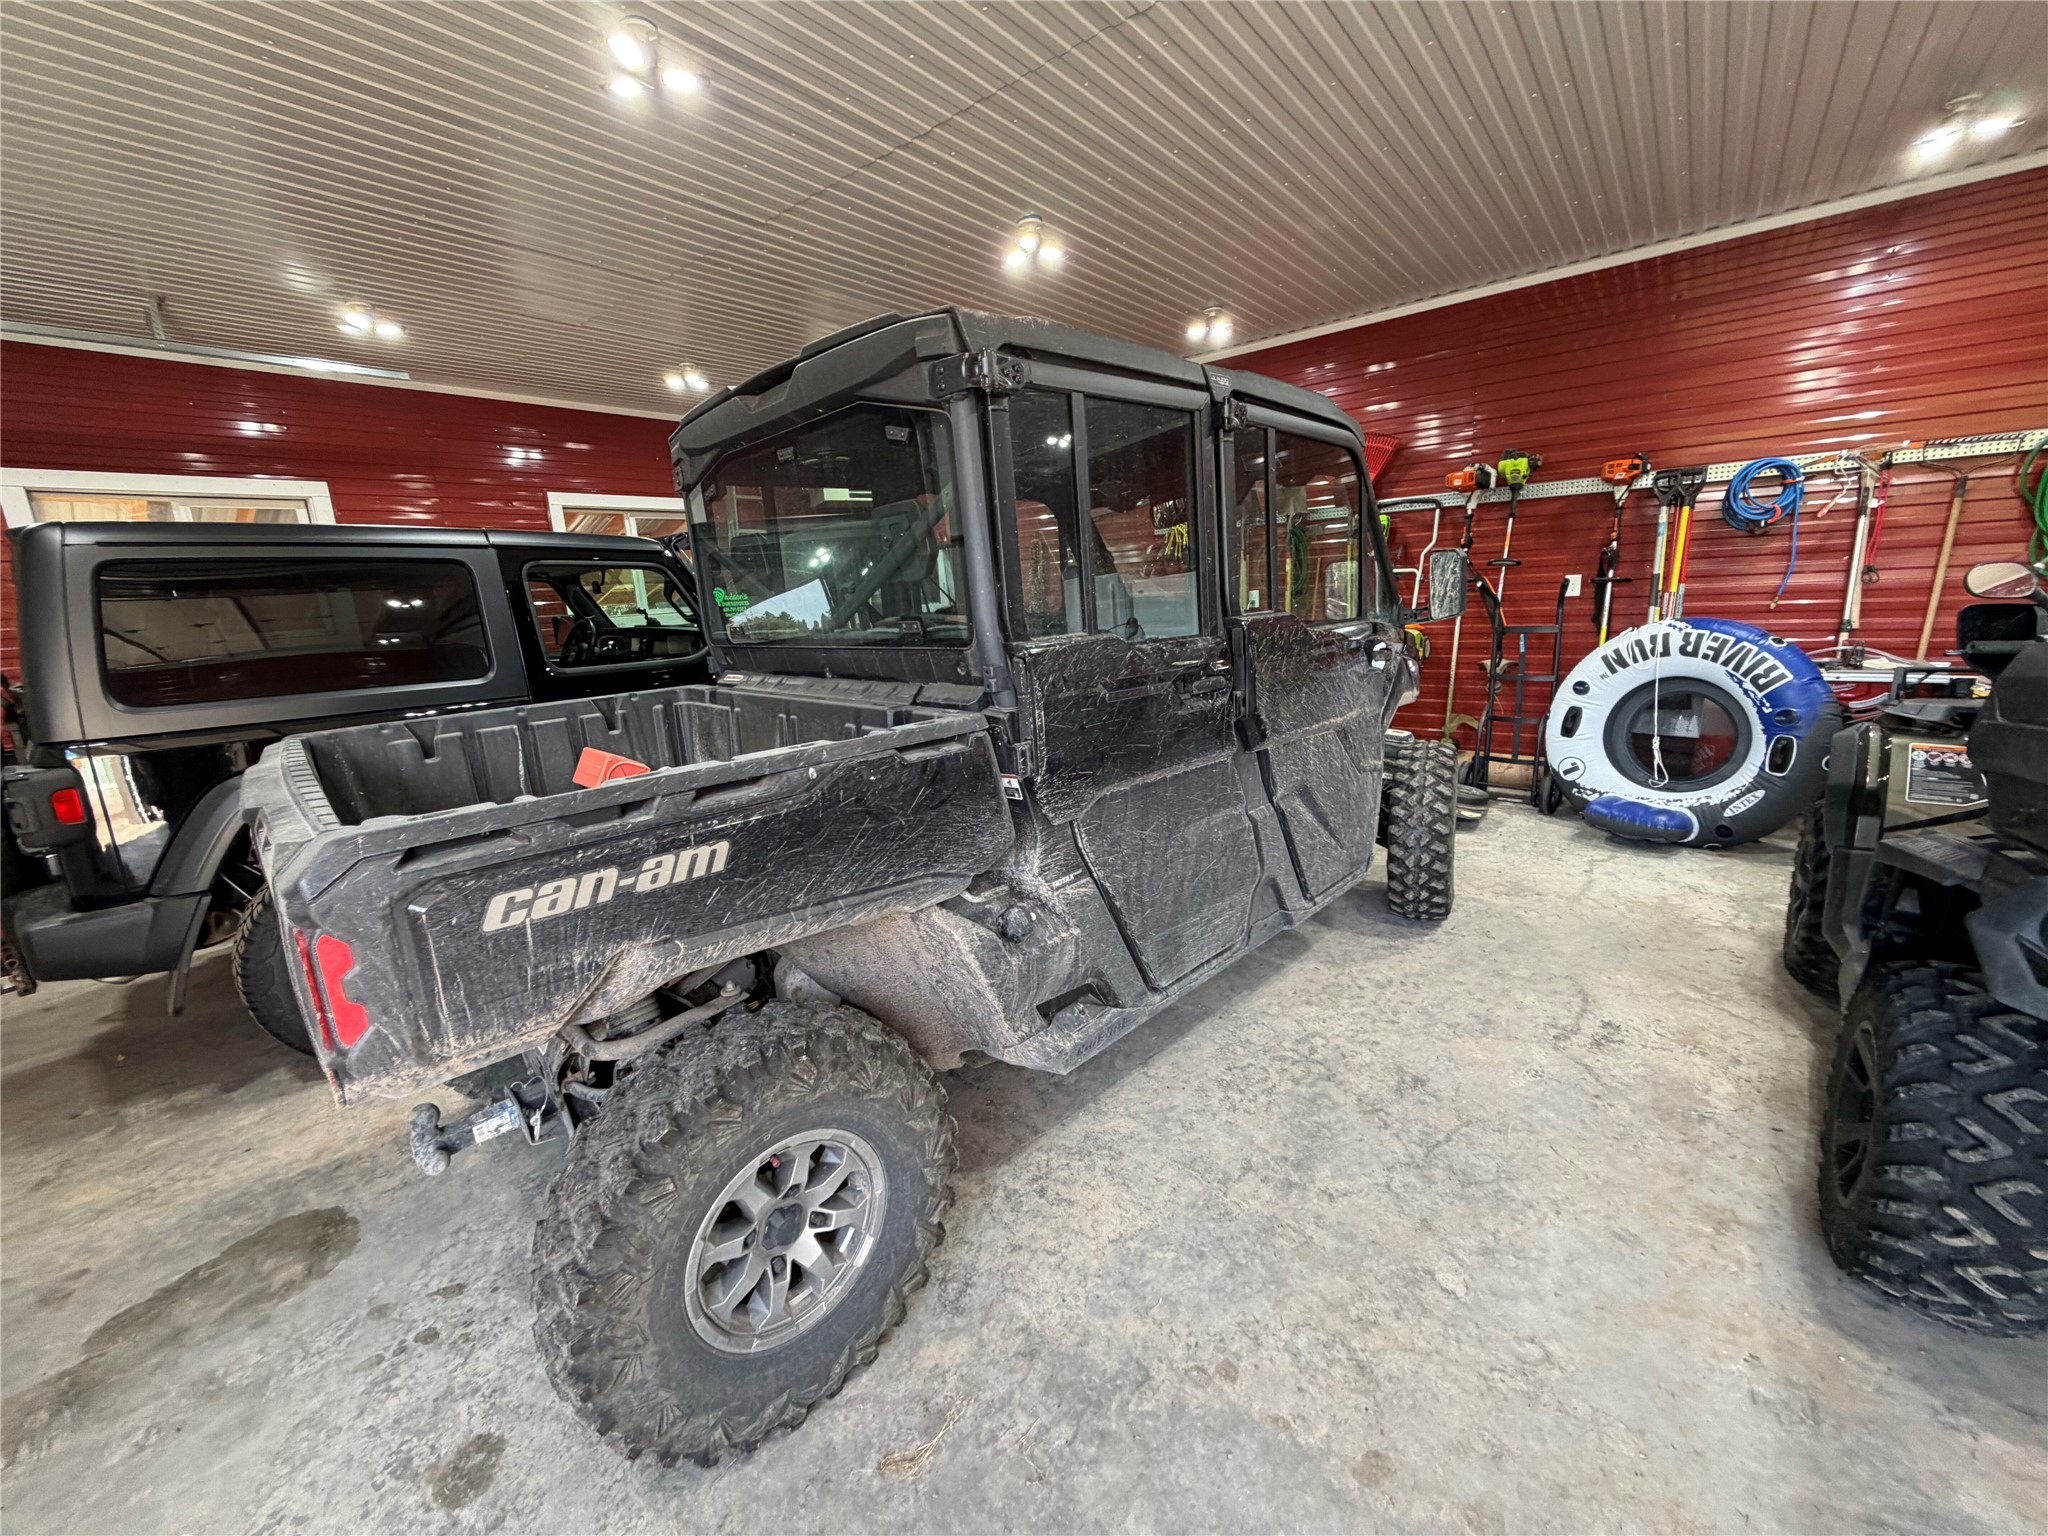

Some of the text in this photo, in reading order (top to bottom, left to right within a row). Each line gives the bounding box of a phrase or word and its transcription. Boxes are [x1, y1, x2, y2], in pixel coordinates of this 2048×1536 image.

[1600, 632, 1672, 675] RUN
[1678, 631, 1788, 693] RIVER
[1729, 792, 1760, 813] INTEX
[483, 841, 731, 932] can-am
